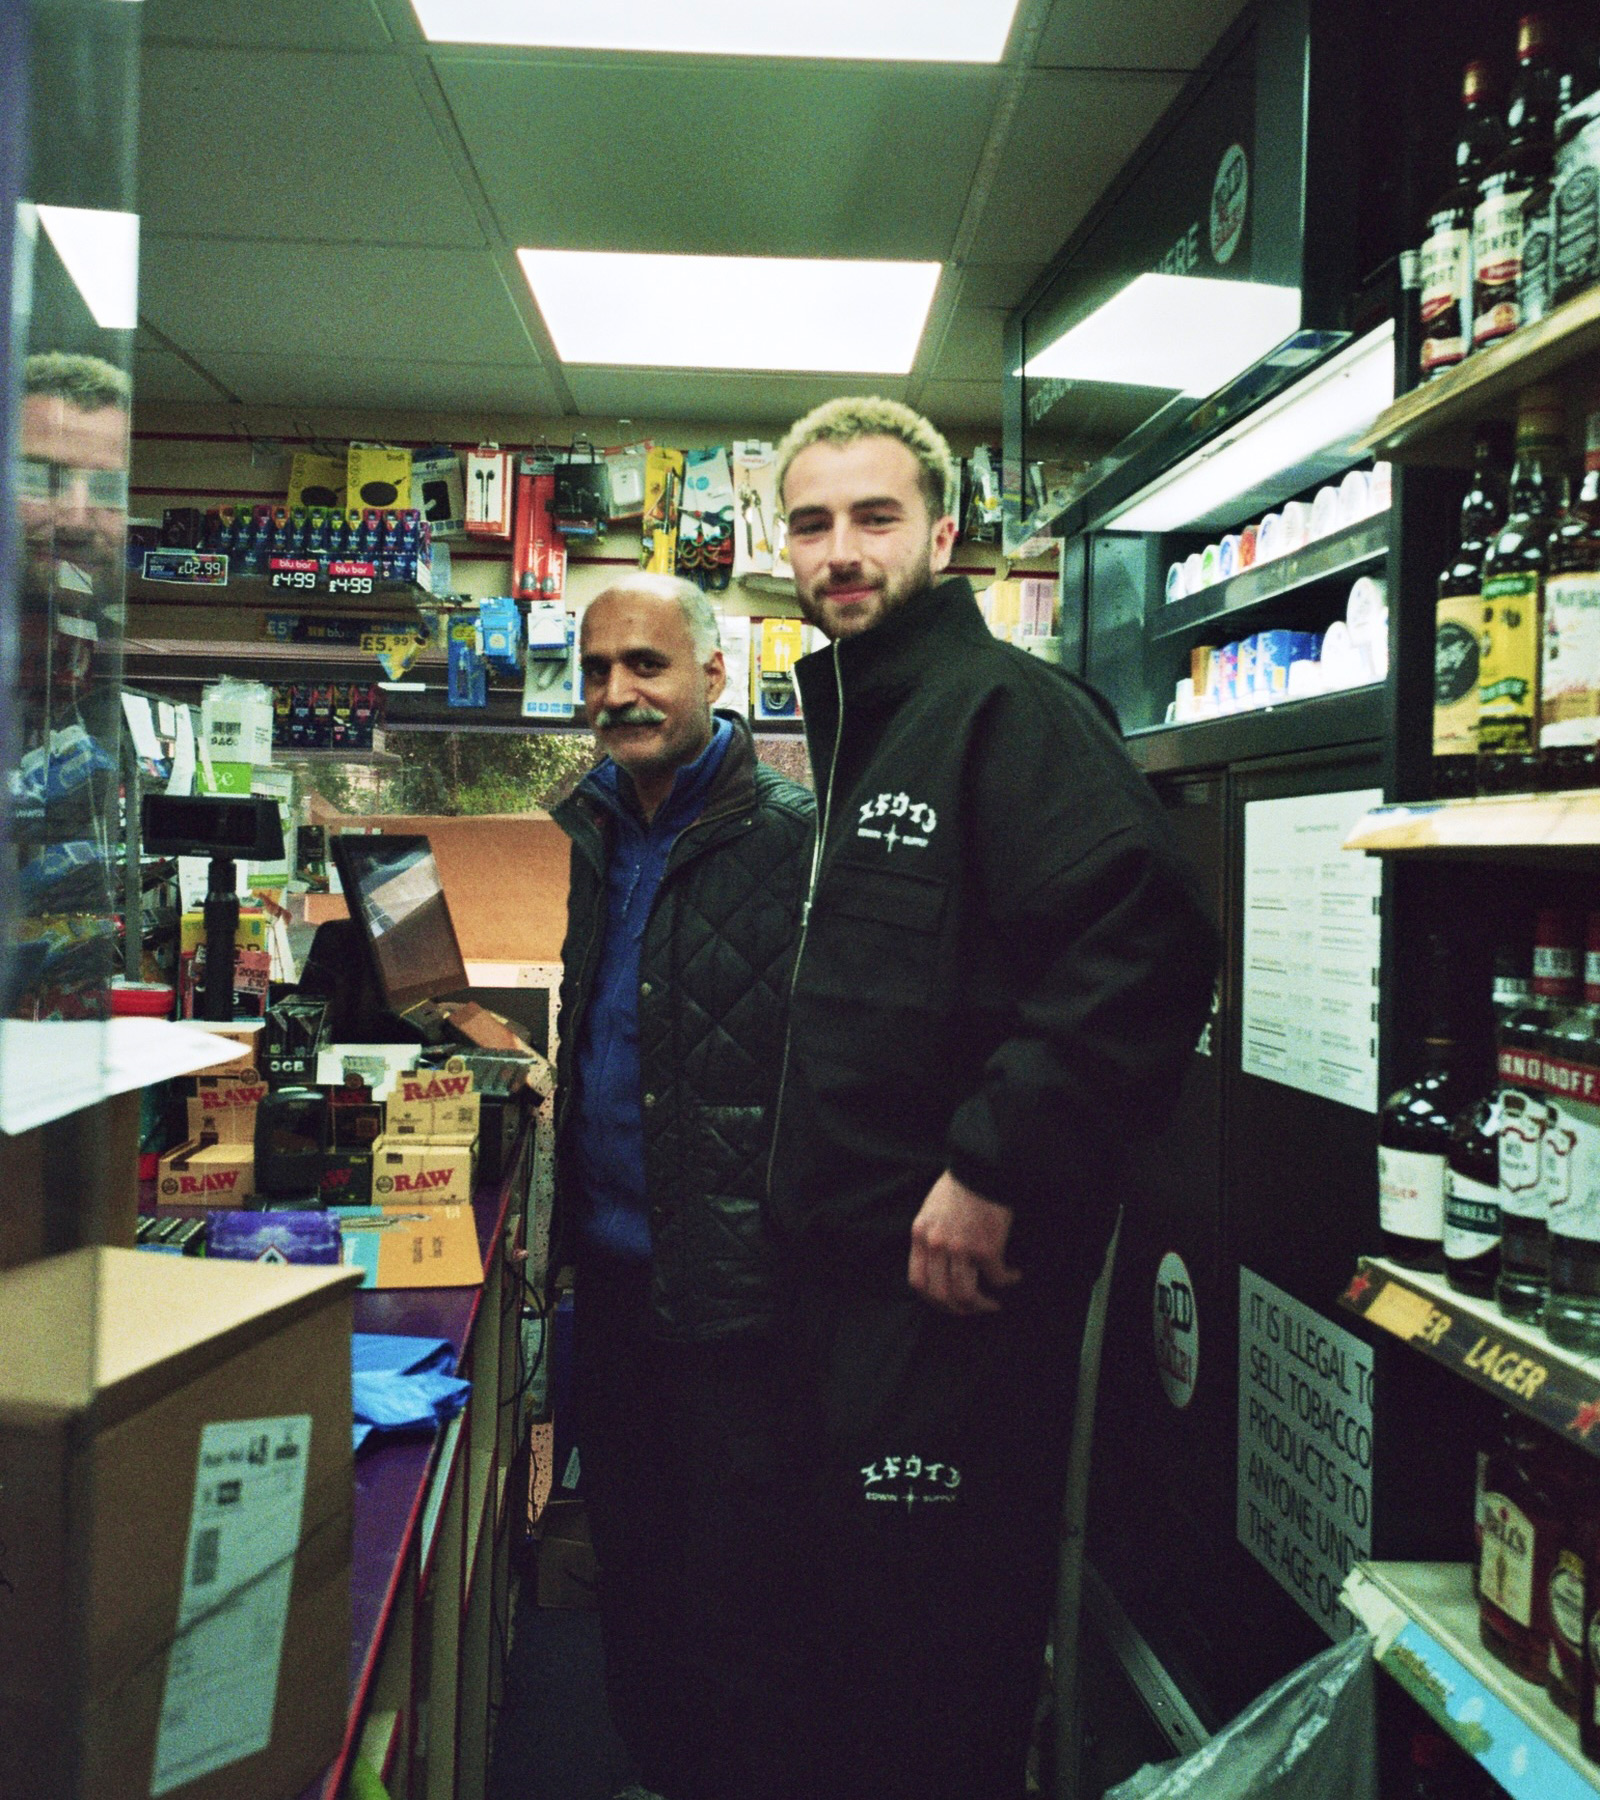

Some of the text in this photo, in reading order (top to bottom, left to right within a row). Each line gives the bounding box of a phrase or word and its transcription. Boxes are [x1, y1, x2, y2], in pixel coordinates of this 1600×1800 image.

[278, 559, 312, 570] blu bar
[335, 564, 368, 575] blu bar
[269, 1060, 305, 1073] OCB
[200, 1086, 266, 1110] RAW
[402, 1075, 471, 1102] RAW
[178, 1170, 240, 1195] RAW
[393, 1167, 455, 1192] RAW
[1251, 1292, 1265, 1331] IT
[1267, 1302, 1280, 1344] IS
[1284, 1315, 1351, 1396] ILLEGAL
[1462, 1334, 1549, 1402] LAGER
[1251, 1344, 1371, 1470] SELL TOBACCO
[1250, 1396, 1368, 1530] PRODUCTS TO
[1248, 1451, 1313, 1541] ANYONE
[1248, 1500, 1278, 1563] THE
[1281, 1536, 1313, 1600] AGE
